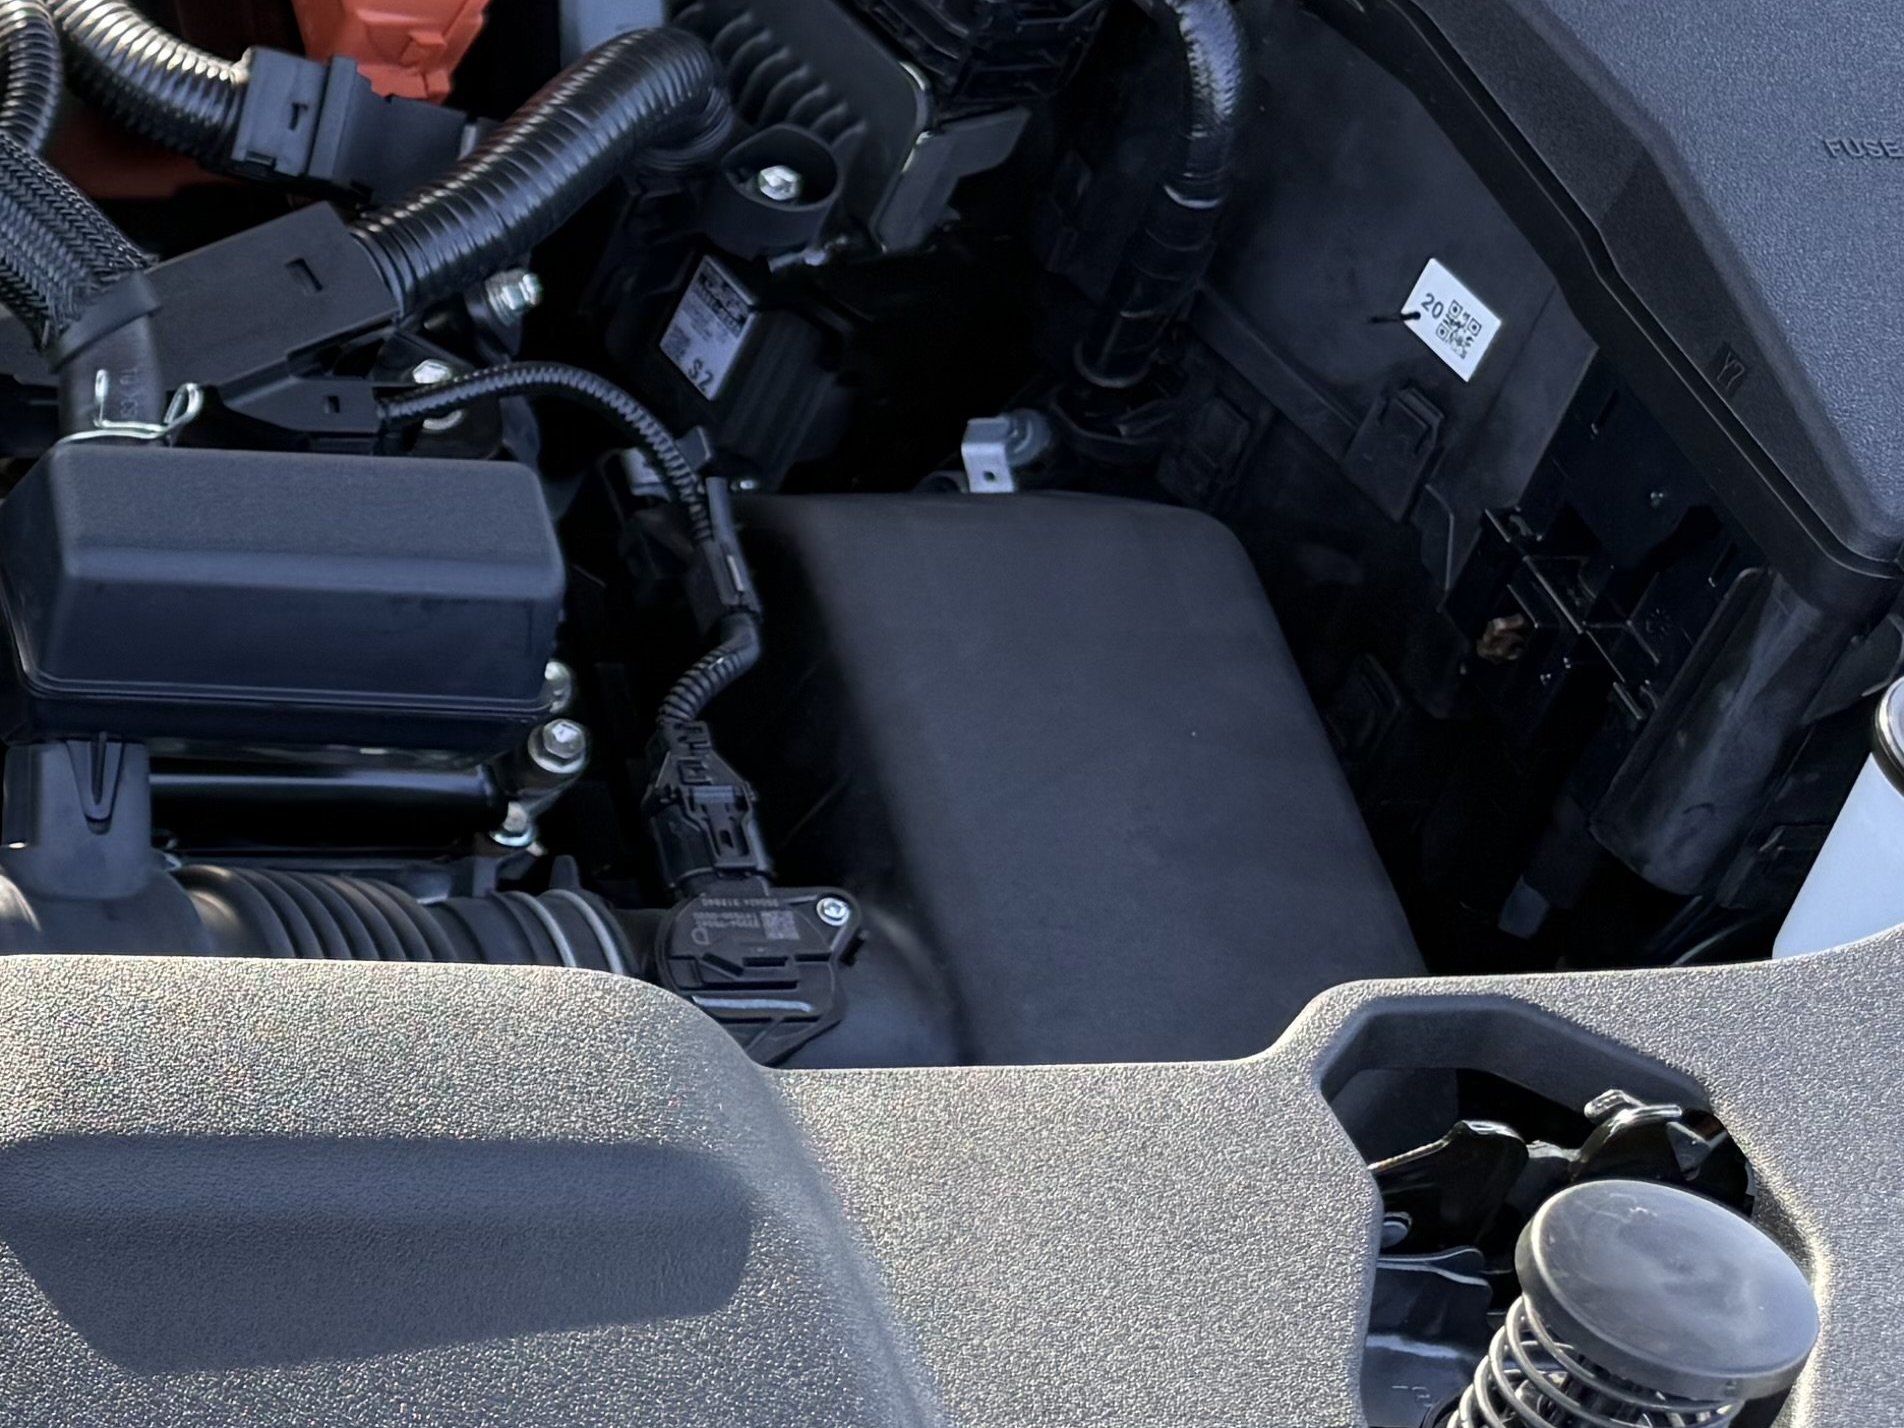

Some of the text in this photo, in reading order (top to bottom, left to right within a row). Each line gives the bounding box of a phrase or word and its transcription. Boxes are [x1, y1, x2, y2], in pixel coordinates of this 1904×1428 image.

[1824, 137, 1904, 159] FUSE
[1421, 292, 1444, 319] 20
[688, 359, 713, 393] S2
